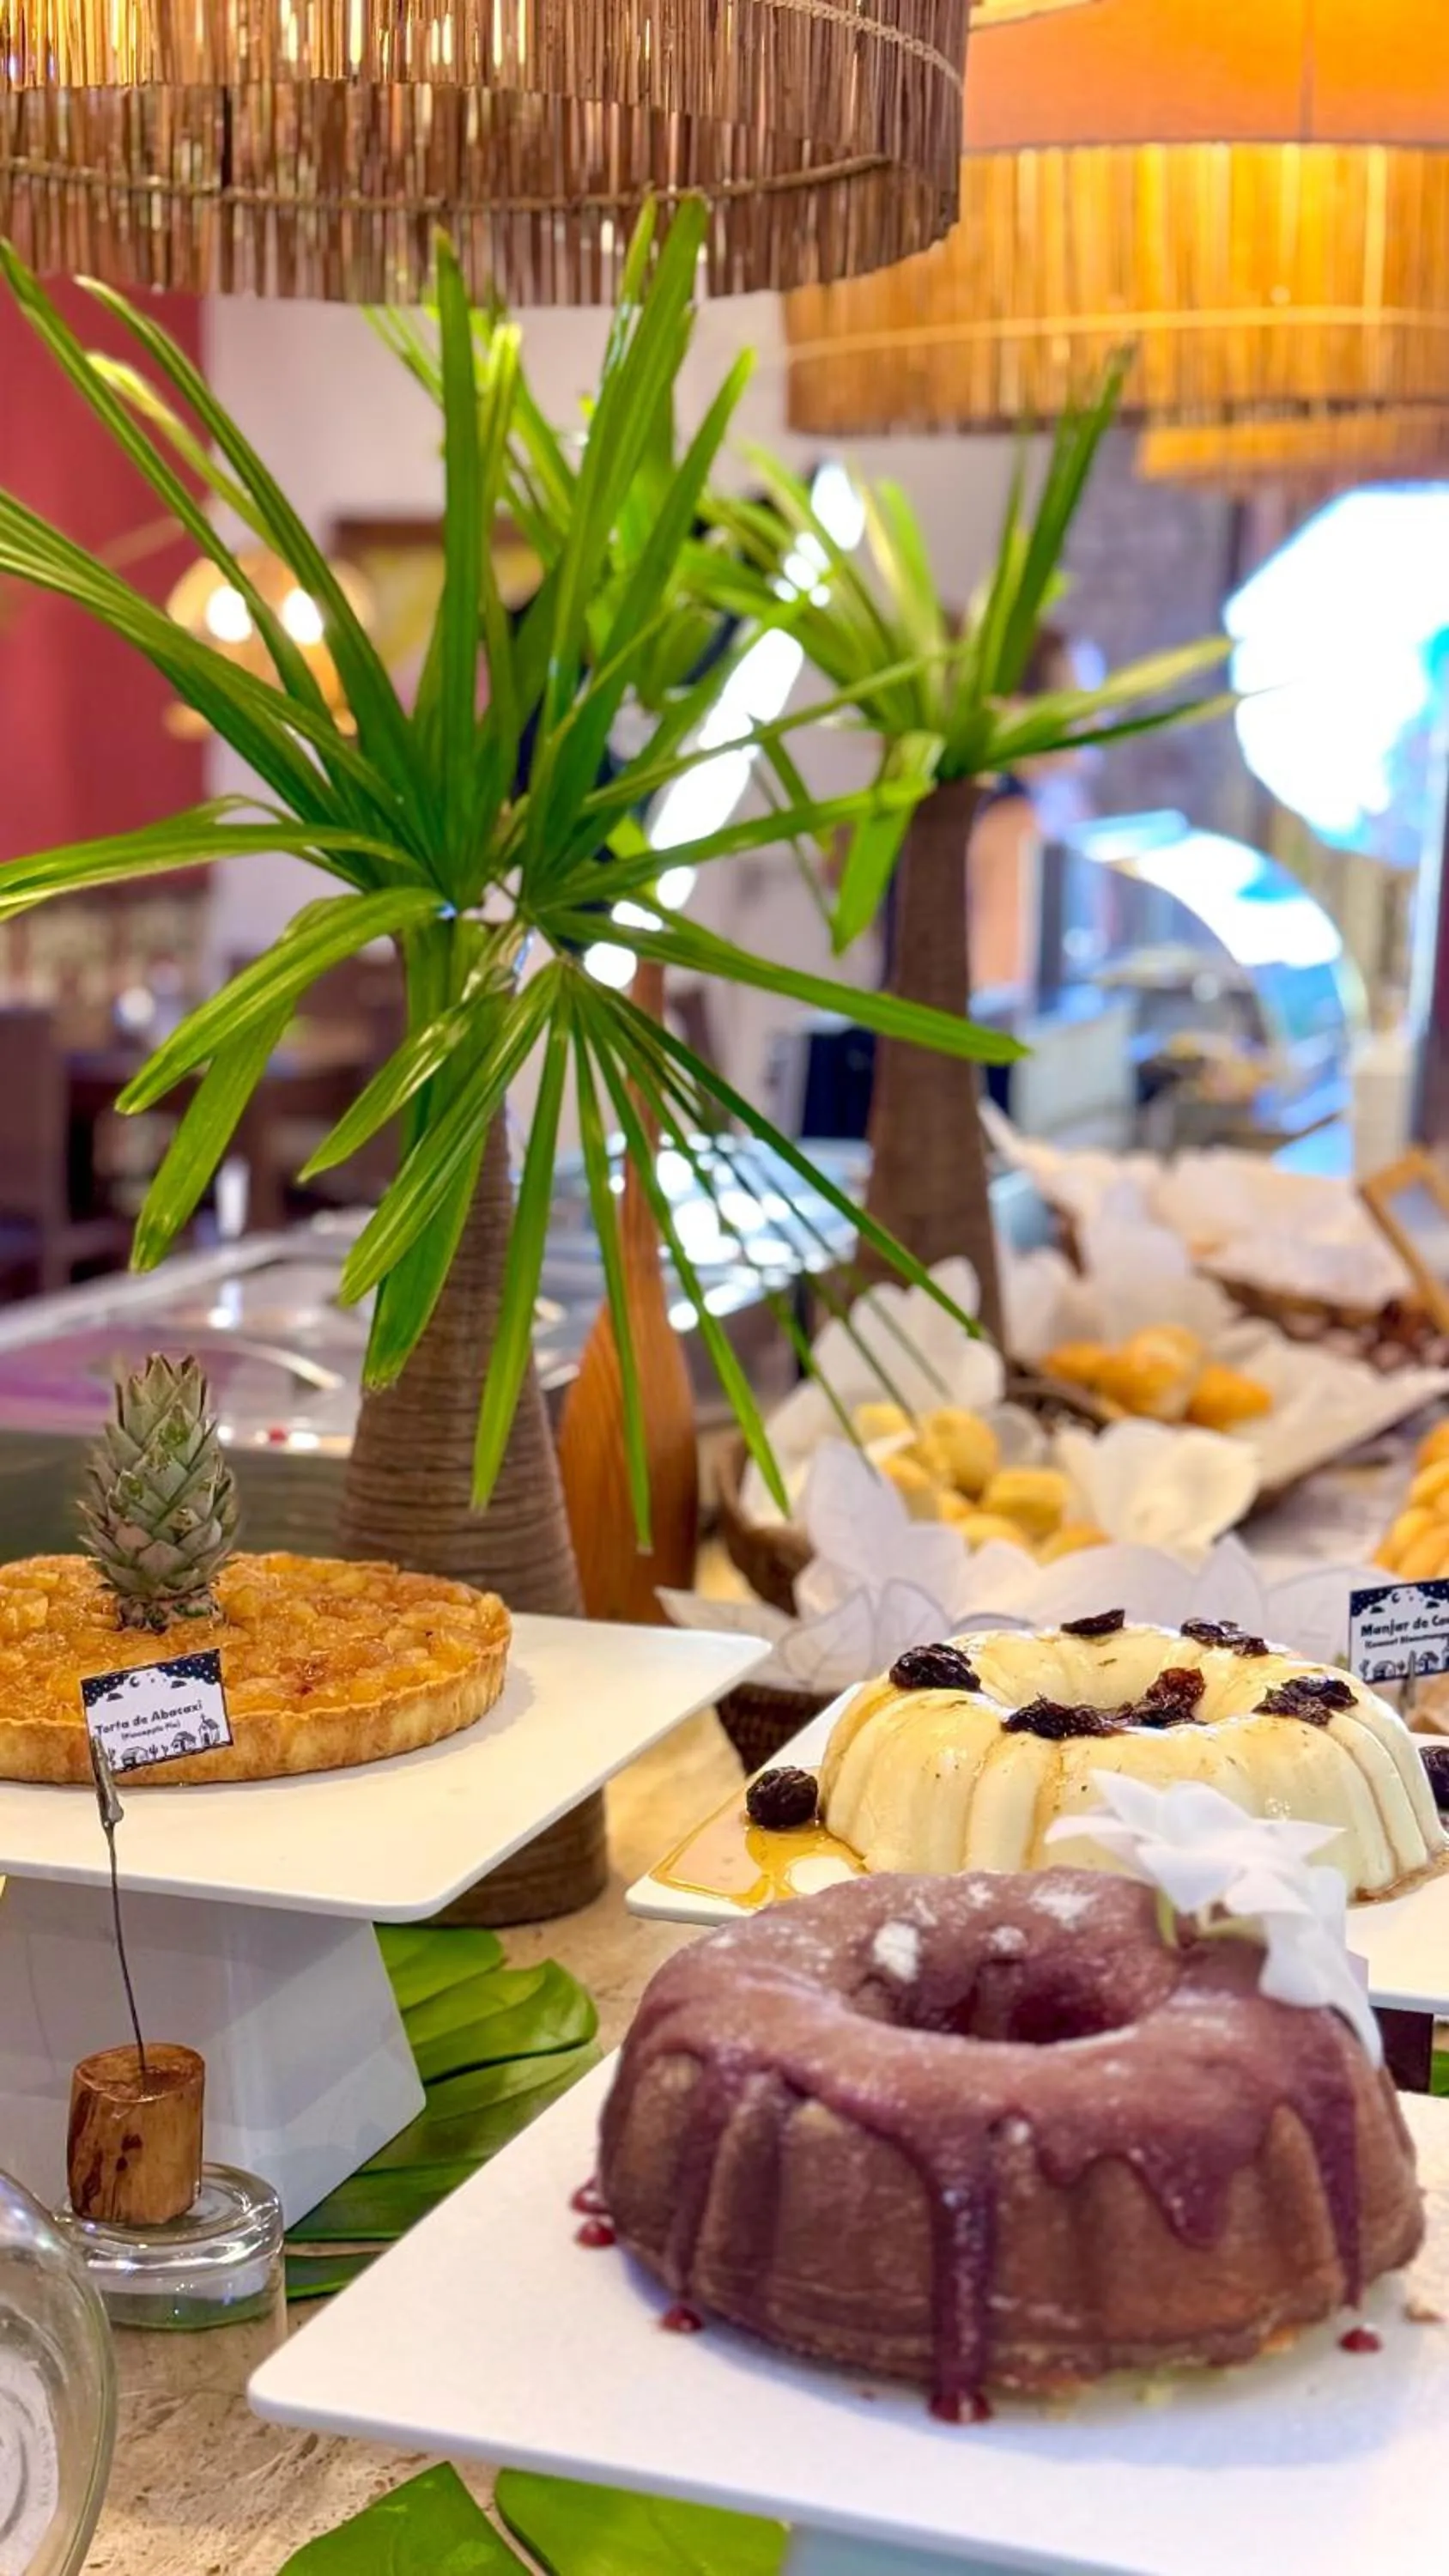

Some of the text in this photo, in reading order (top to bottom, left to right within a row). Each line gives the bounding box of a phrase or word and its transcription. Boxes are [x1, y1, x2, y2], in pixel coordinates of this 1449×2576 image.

[1361, 1619, 1410, 1637] Manjar
[1413, 1617, 1428, 1630] de
[94, 1720, 130, 1736] Torta
[132, 1715, 149, 1727] de
